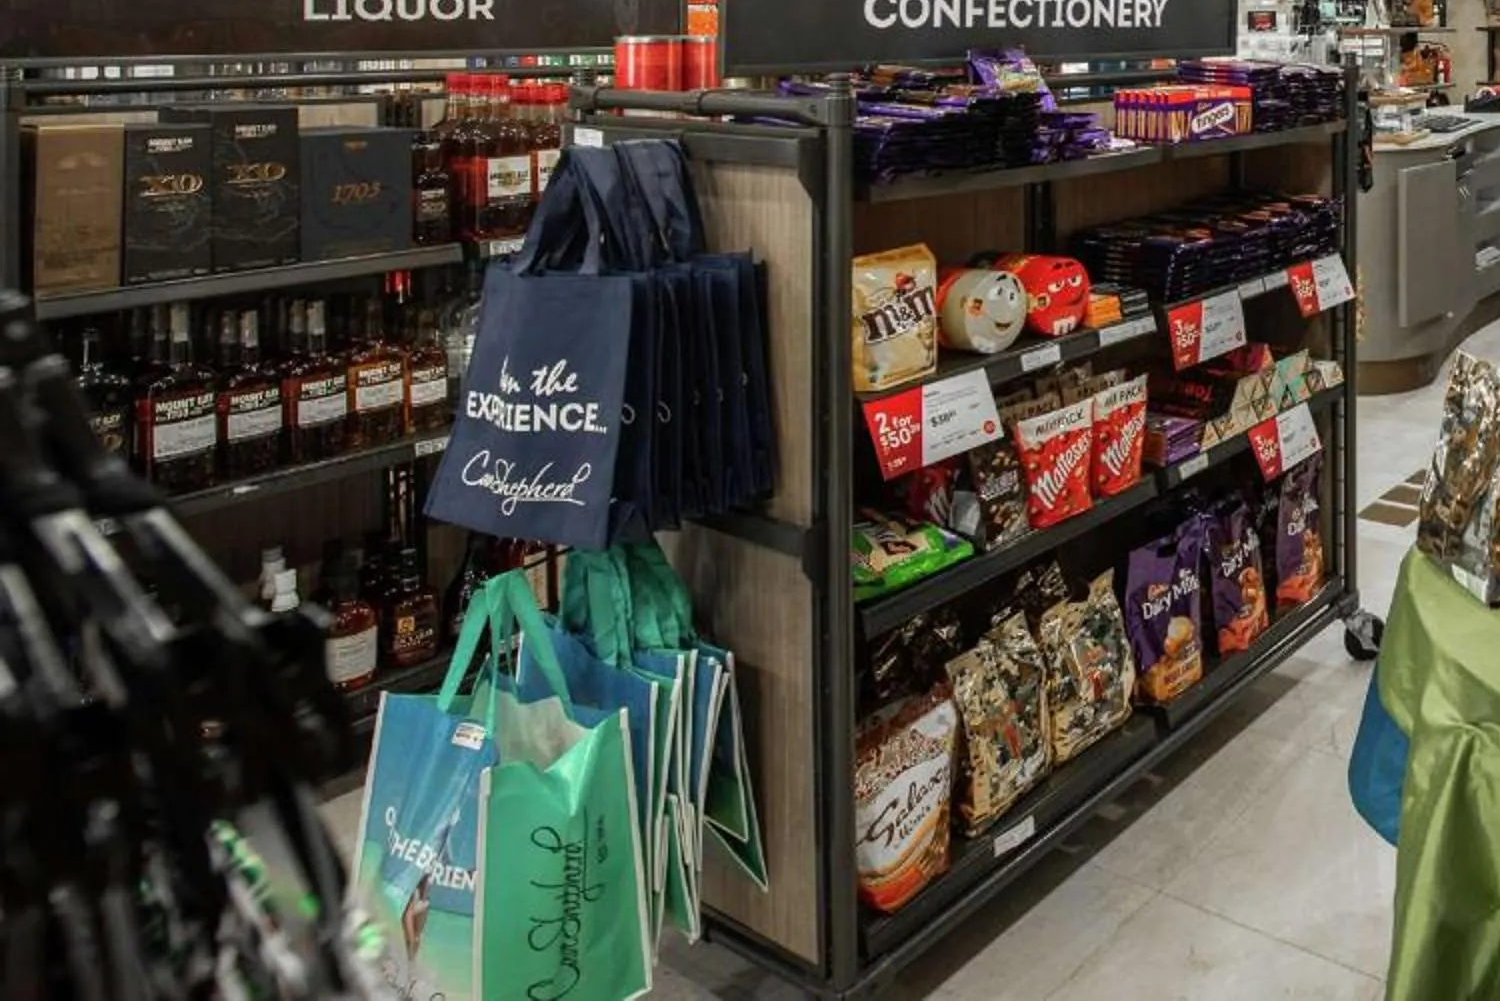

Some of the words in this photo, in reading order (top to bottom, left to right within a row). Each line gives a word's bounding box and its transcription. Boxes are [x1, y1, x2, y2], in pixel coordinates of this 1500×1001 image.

[530, 358, 579, 397] the
[874, 412, 890, 434] 2
[1141, 591, 1173, 621] Dairy
[1171, 574, 1200, 601] Milk
